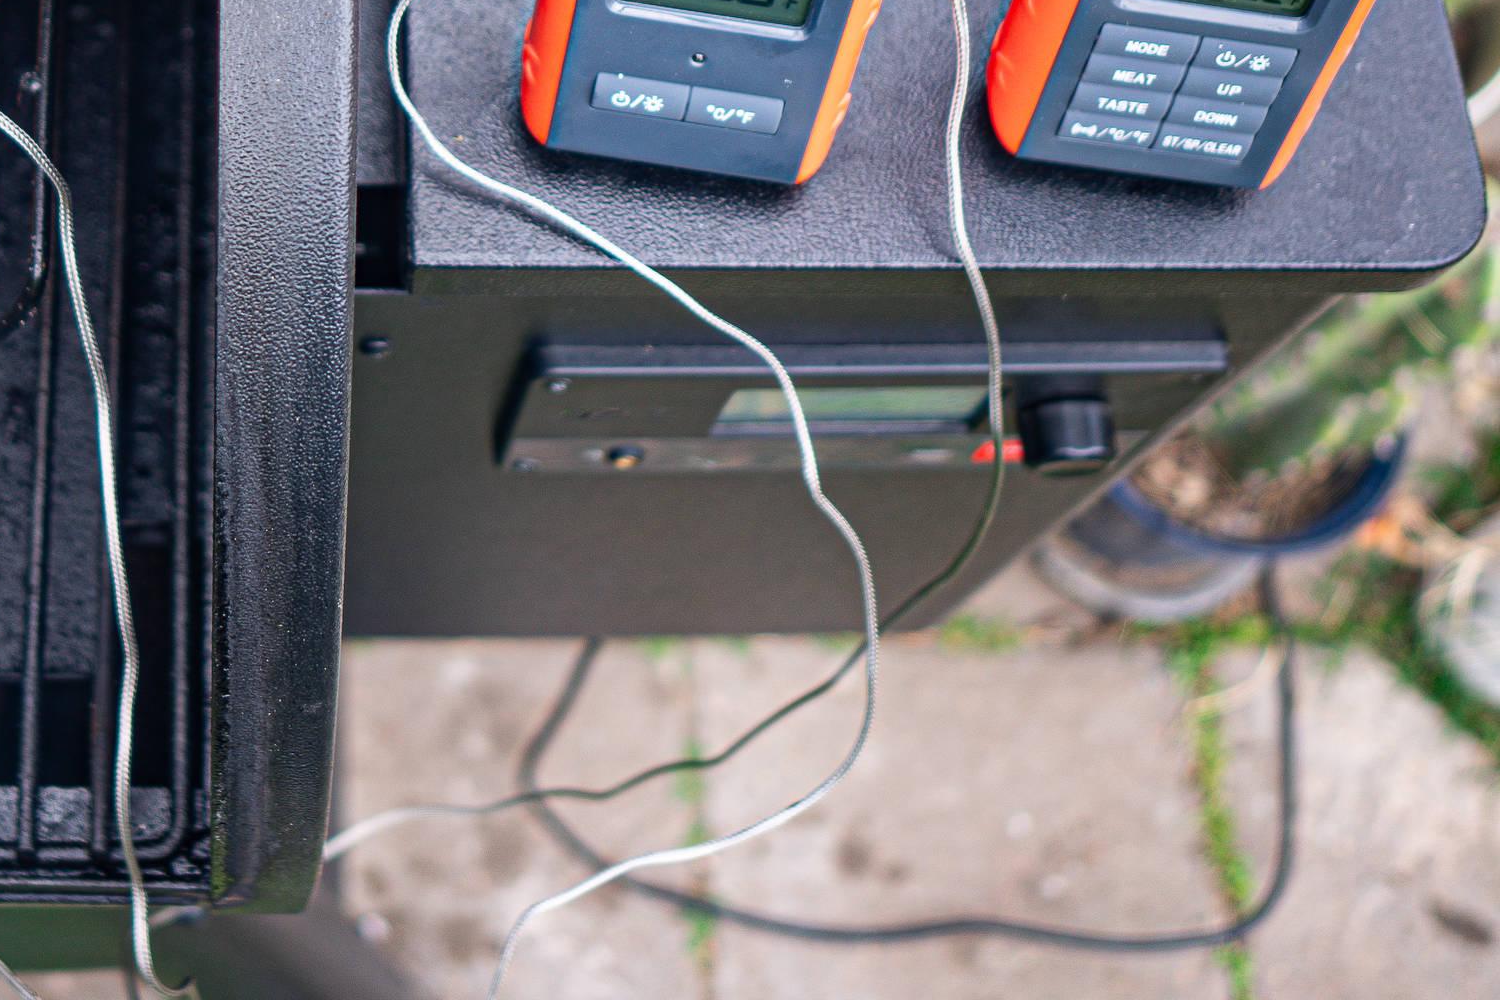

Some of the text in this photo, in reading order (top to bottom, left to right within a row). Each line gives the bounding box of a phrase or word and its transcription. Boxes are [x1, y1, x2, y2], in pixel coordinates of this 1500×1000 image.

[1124, 40, 1170, 57] MODE
[1112, 69, 1157, 86] MEAT
[1216, 83, 1243, 97] UP
[1098, 97, 1149, 115] TASTE
[1193, 110, 1239, 127] DOWN
